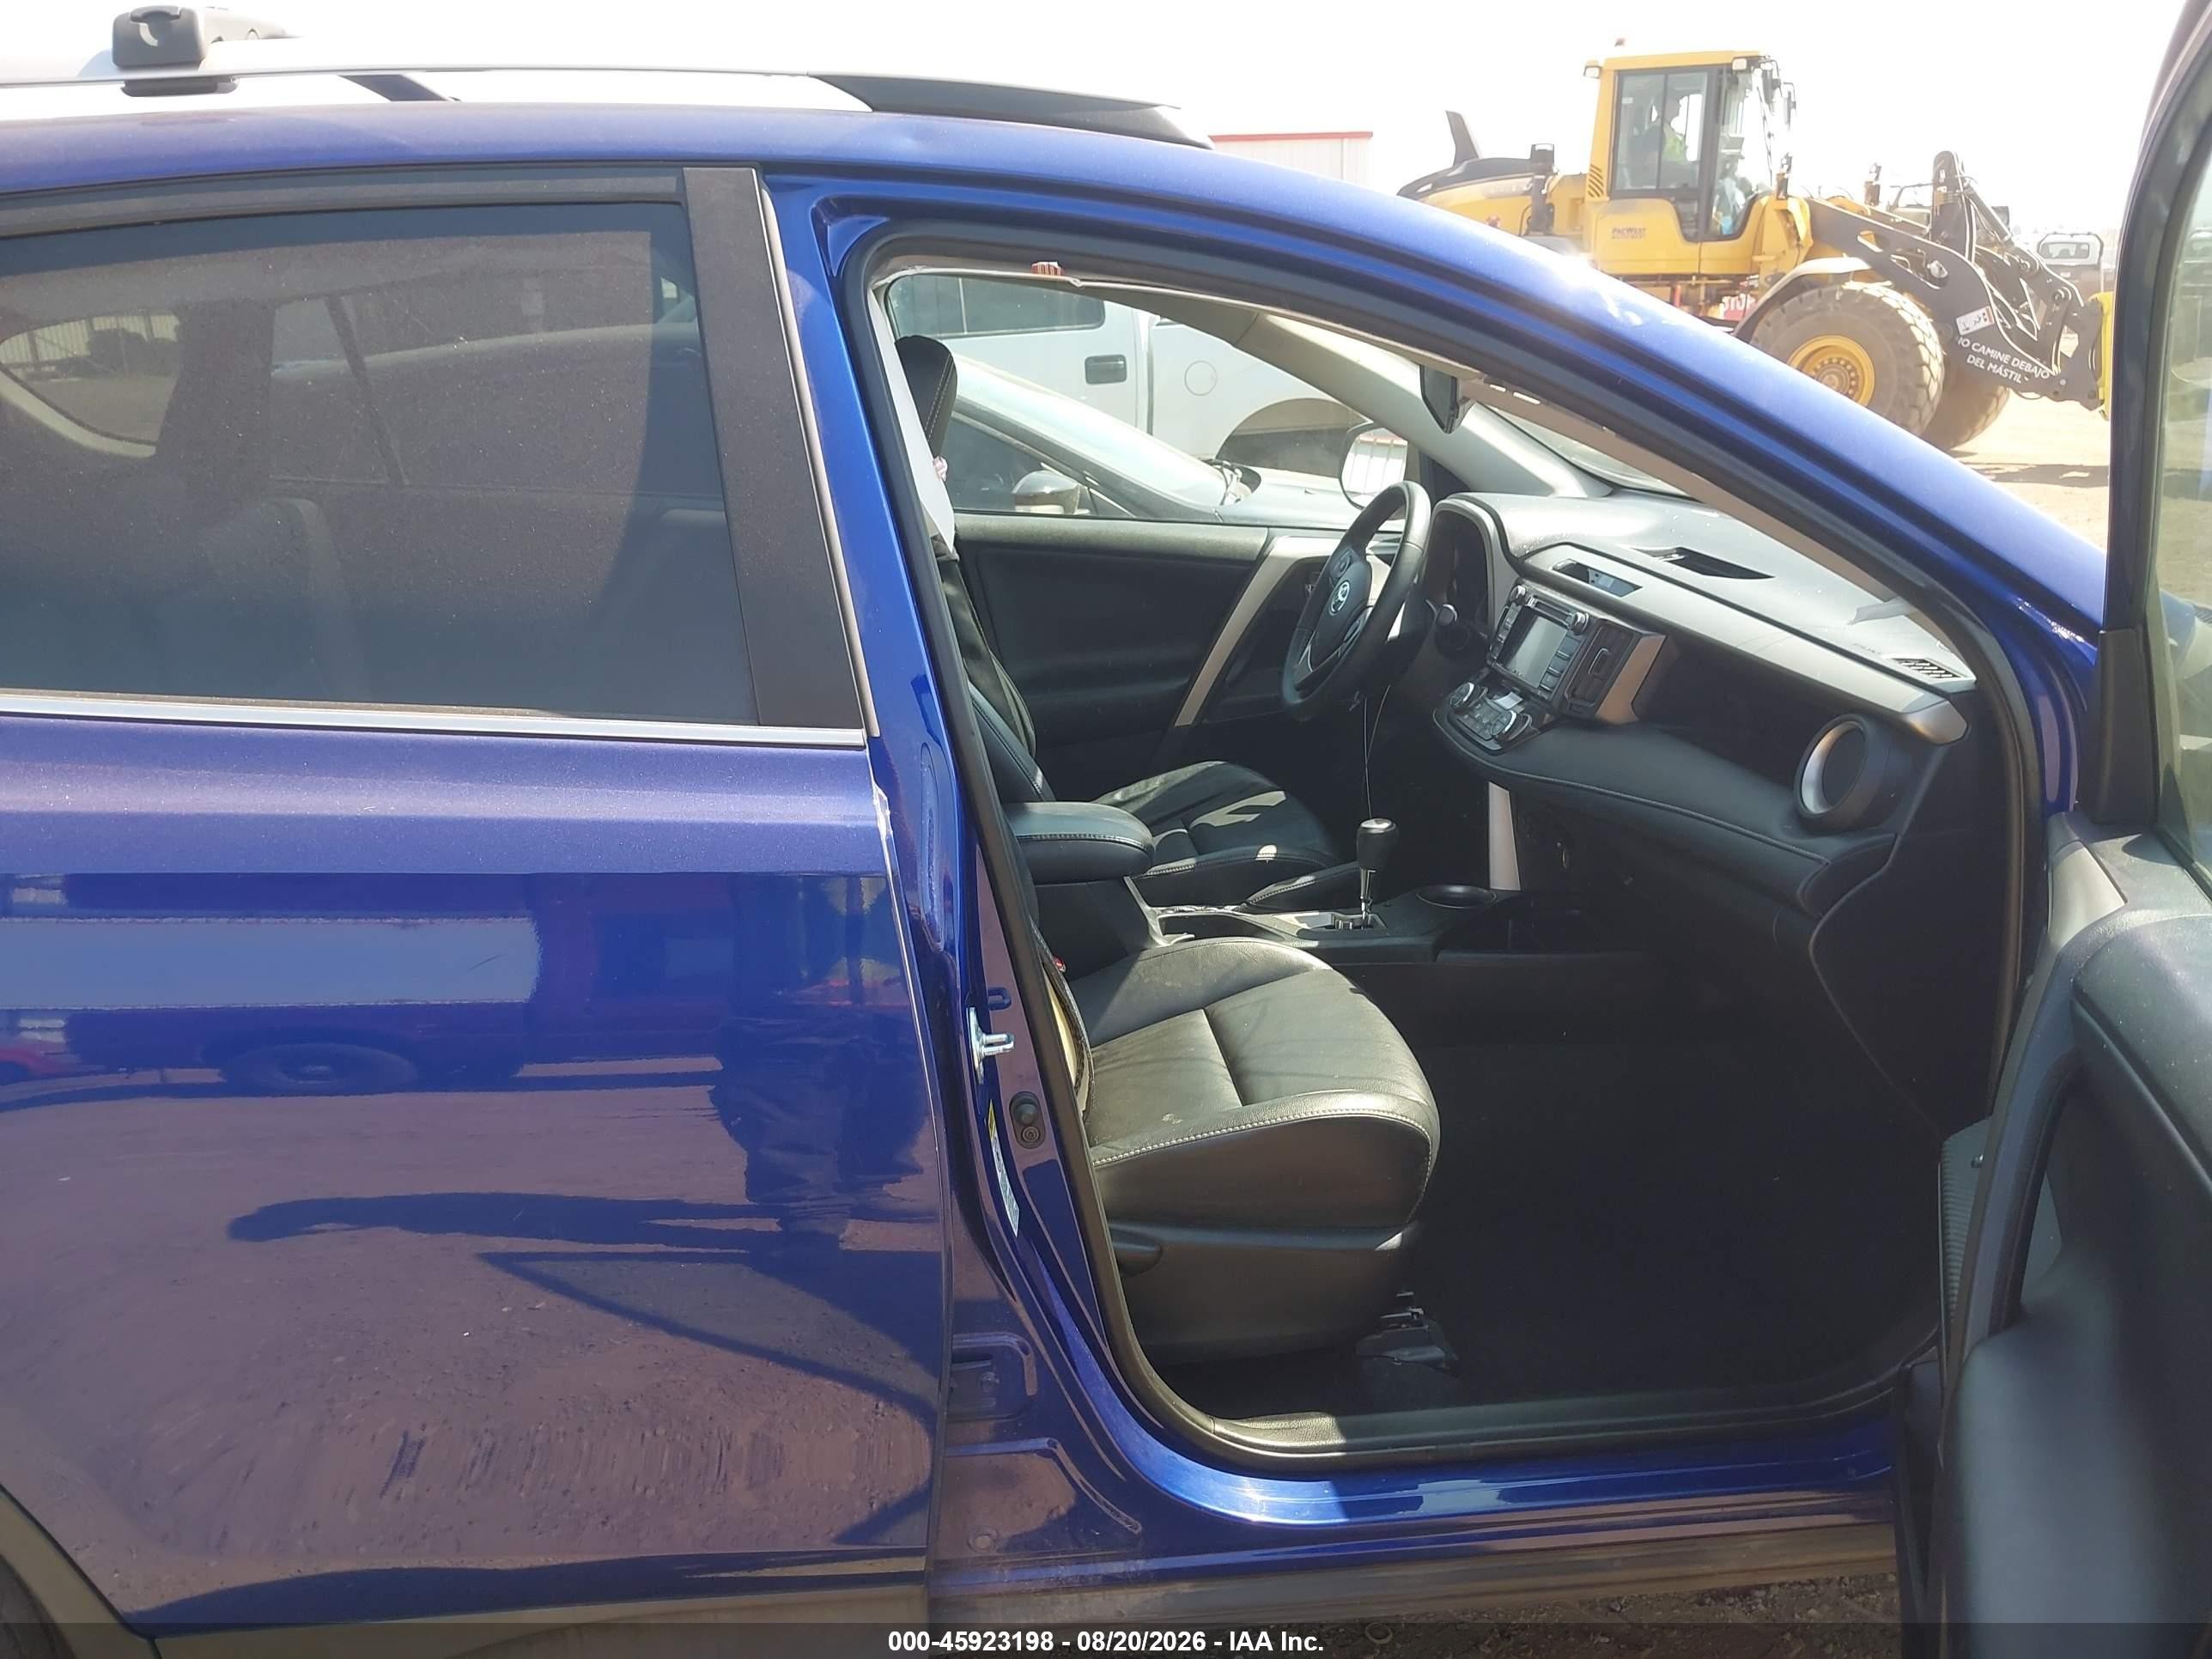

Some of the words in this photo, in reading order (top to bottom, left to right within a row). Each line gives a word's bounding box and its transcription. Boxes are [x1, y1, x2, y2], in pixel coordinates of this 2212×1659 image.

[1966, 355, 1985, 369] DEL
[1987, 363, 2021, 384] MÁSTIL
[1971, 343, 2011, 364] CAMINE
[2011, 357, 2050, 379] DEBAJO
